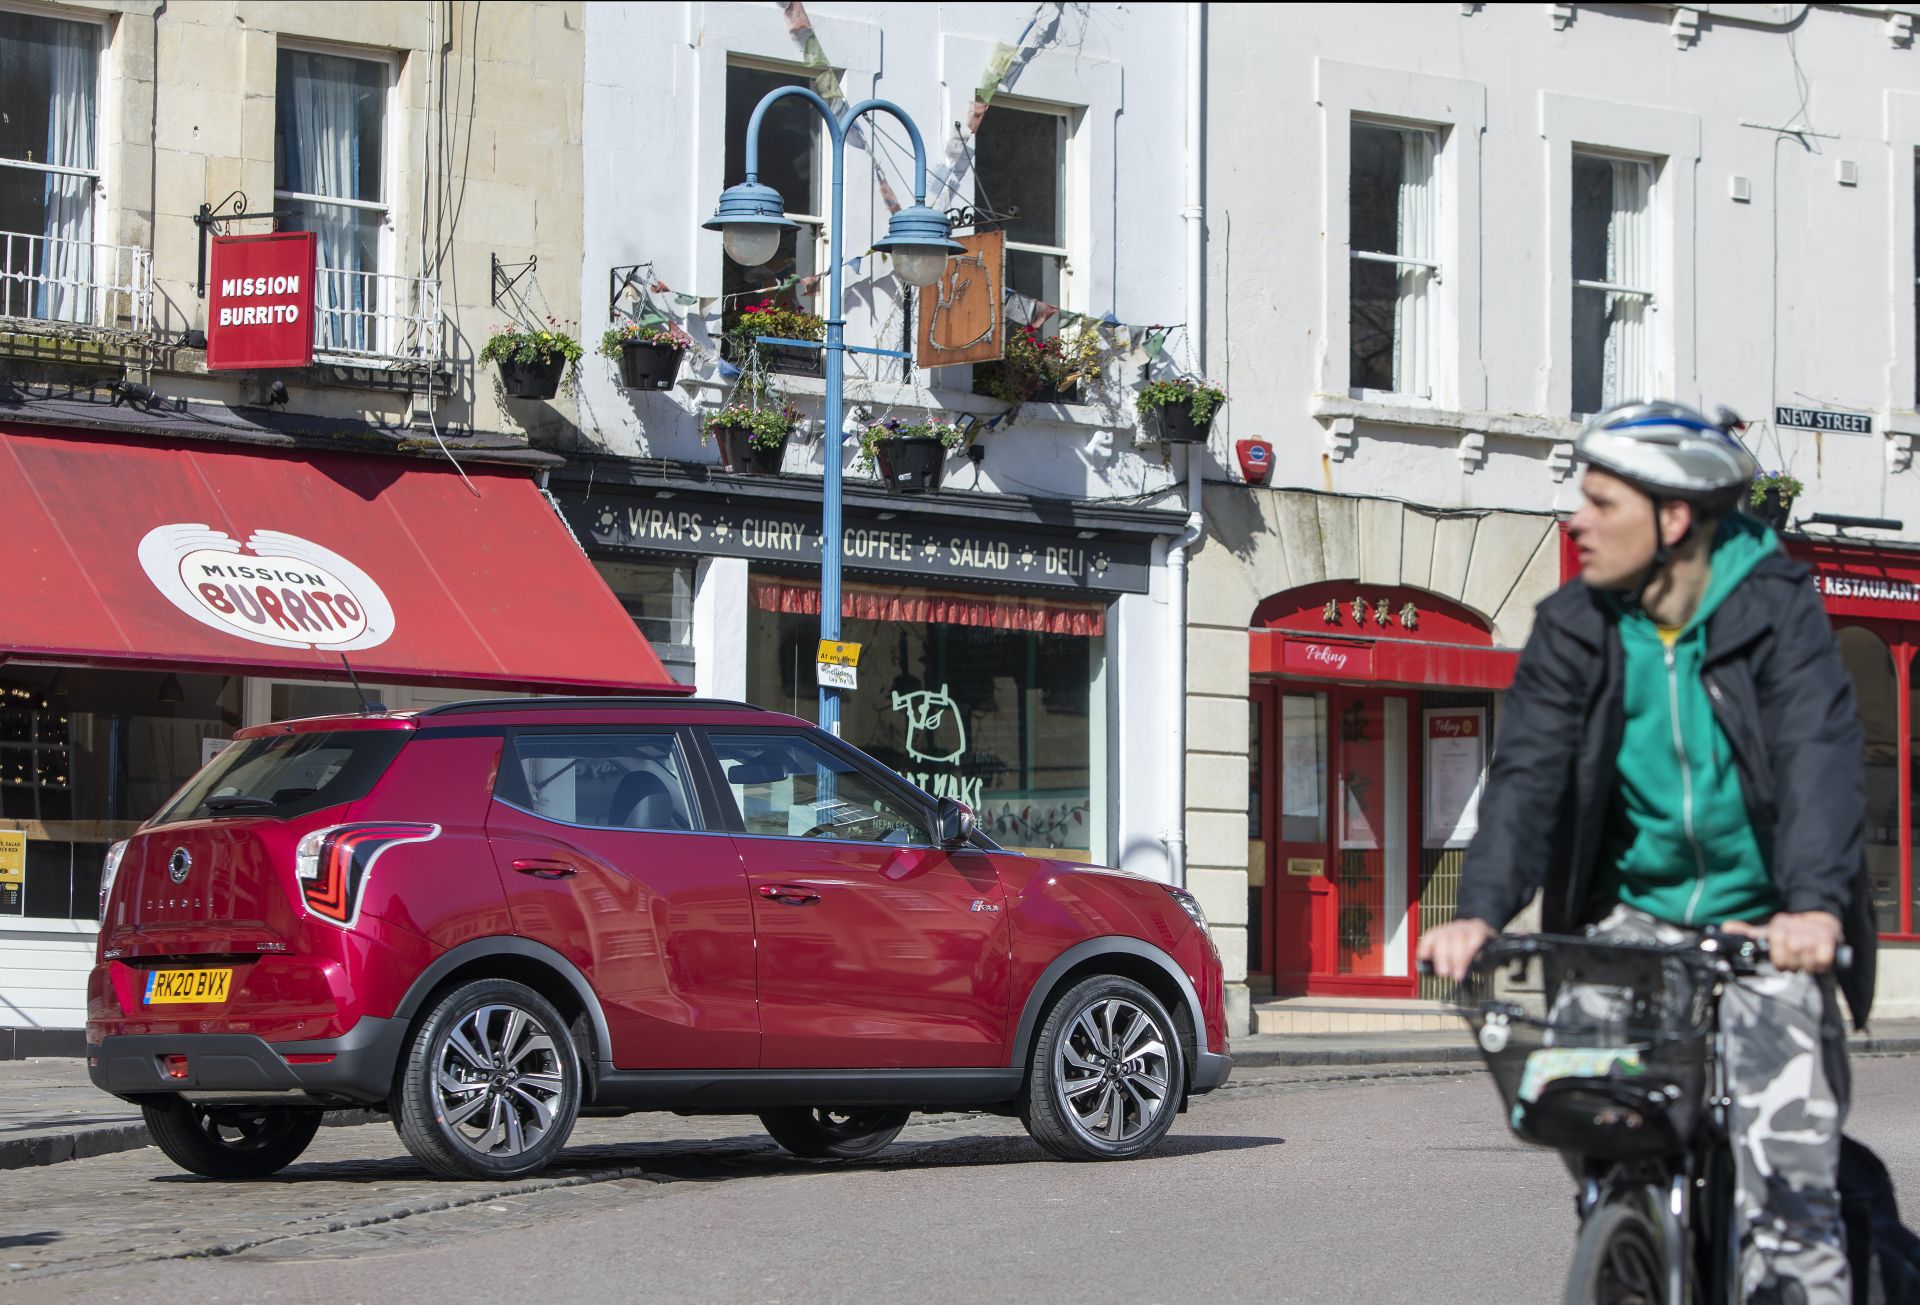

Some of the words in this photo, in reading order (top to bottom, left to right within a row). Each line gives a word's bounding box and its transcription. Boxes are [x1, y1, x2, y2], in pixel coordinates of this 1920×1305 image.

[222, 276, 299, 297] MISSION
[220, 305, 298, 326] BURRITO
[1780, 408, 1813, 426] NEW
[1816, 412, 1869, 432] STREET
[628, 507, 702, 542] WRAPS
[742, 518, 806, 552] CURRY
[843, 528, 912, 562] COFFEE
[949, 538, 1009, 570] SALAD
[1045, 546, 1083, 576] DELI
[200, 565, 327, 586] MISSION
[1824, 576, 1920, 602] RESTAURANT
[198, 583, 360, 632] BURRITO
[1305, 643, 1348, 670] Peking
[155, 972, 195, 997] RK20
[196, 971, 228, 996] BVX
